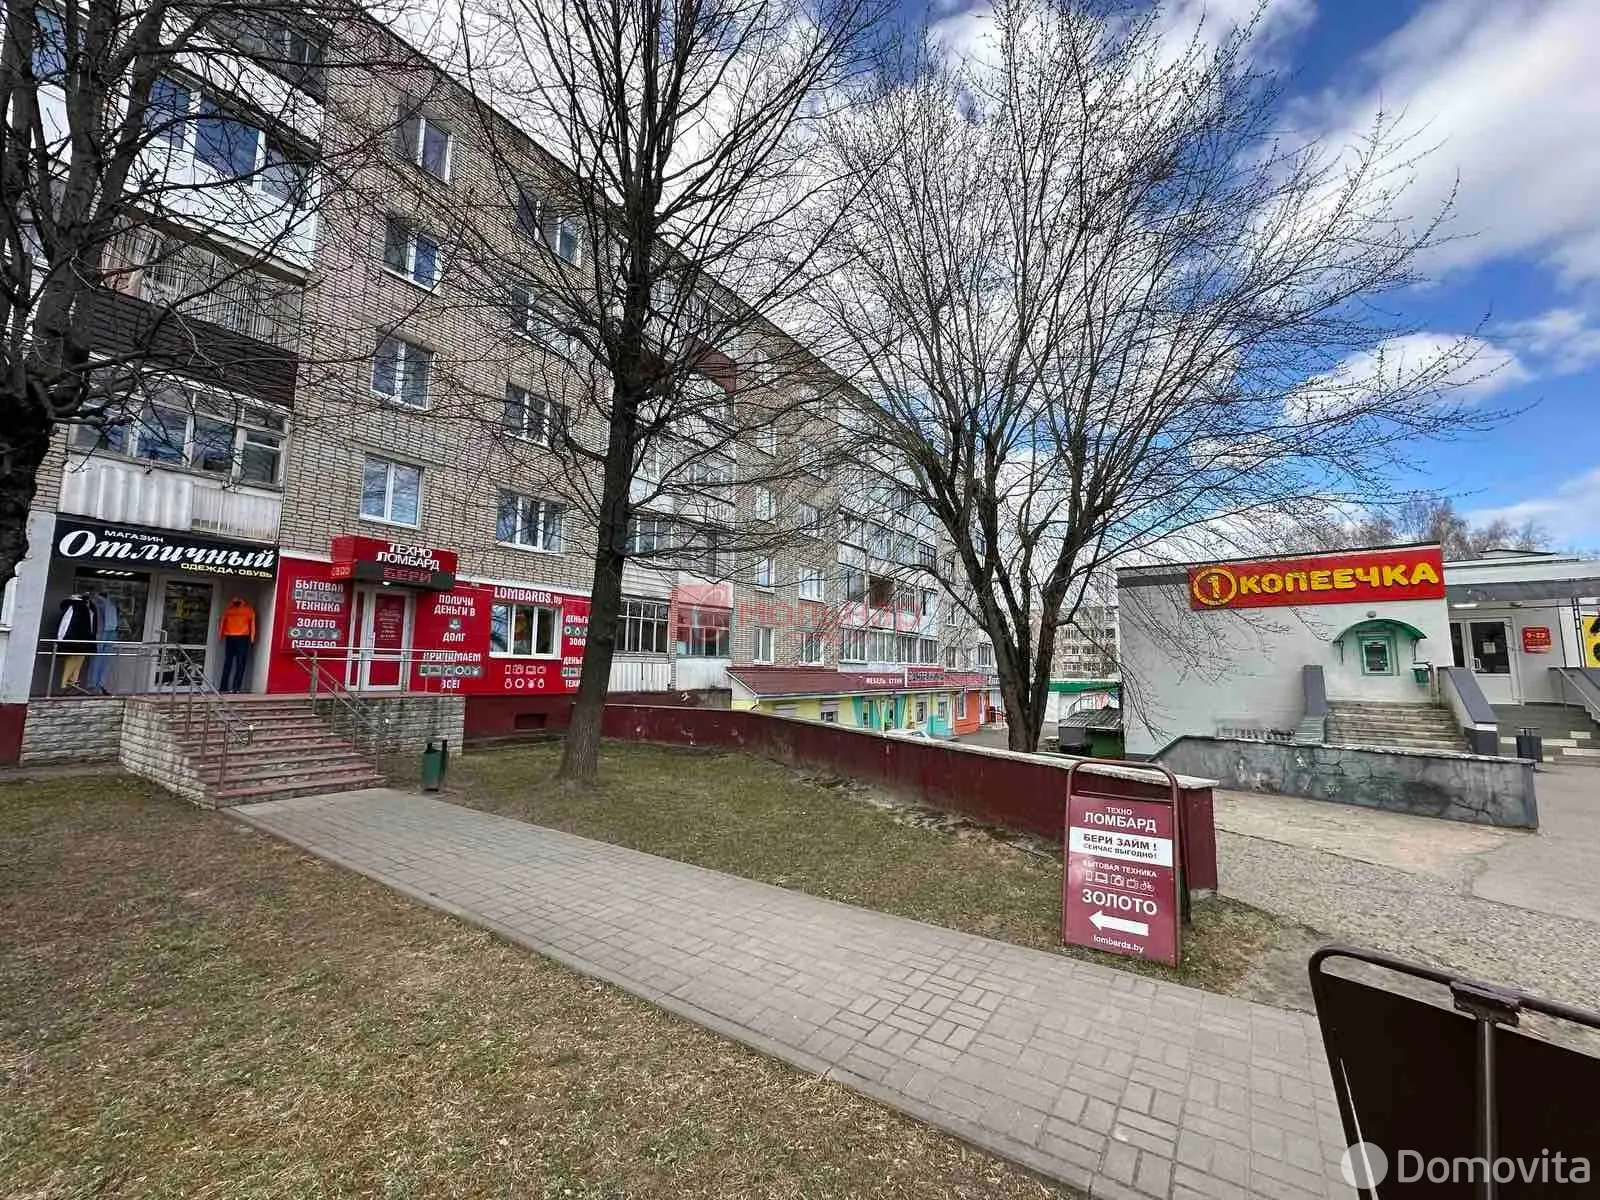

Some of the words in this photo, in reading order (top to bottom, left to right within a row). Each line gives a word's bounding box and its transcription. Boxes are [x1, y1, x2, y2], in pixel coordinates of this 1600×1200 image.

[104, 530, 164, 543] МАГАЗИН
[59, 530, 275, 568] Отличный
[387, 543, 433, 558] ТЕХНО
[376, 552, 440, 572] ЛОМБАРД
[180, 562, 234, 575] ОДЕЖДА
[238, 568, 273, 578] ОБУВЬ
[1239, 562, 1440, 595] КОПЕЕЧКА
[295, 580, 344, 593] БЫТОВАЯ
[295, 600, 341, 613] ТЕХНИКА
[438, 594, 475, 606] ПОЛУЧИ
[433, 604, 468, 616] ДЕНЬГИ
[469, 607, 476, 617] В
[296, 617, 337, 629] ЗОЛОТО
[442, 631, 467, 642] ДОЛГ
[1105, 806, 1133, 816] ТЕХНО
[1083, 811, 1157, 834] ЛОМБАРД
[1082, 833, 1113, 846] БЕРИ
[1115, 838, 1150, 851] ЗАЙМ
[1121, 865, 1158, 878] ТЕХНИКА
[1081, 888, 1158, 917] ЗОЛОТО
[1093, 934, 1144, 954] lombards.by
